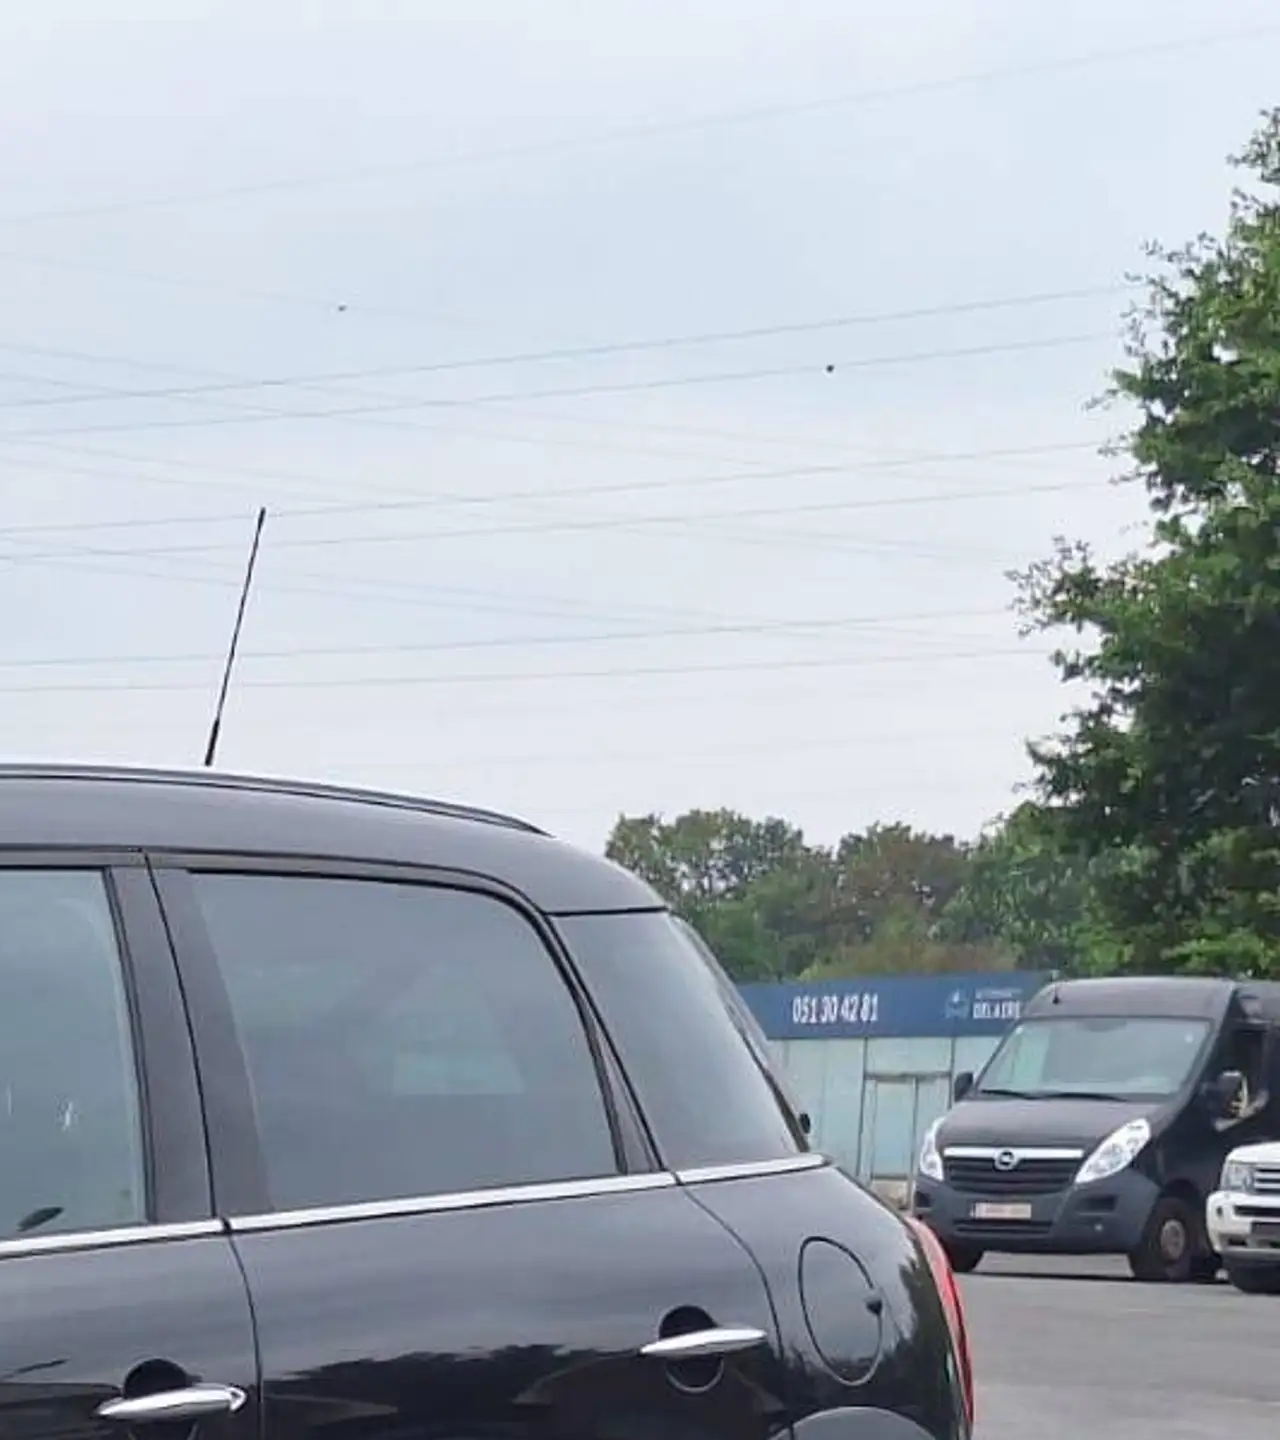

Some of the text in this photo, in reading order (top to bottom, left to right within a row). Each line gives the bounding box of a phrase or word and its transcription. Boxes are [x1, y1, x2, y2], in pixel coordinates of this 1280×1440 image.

[792, 993, 879, 1024] 051 30 42 81
